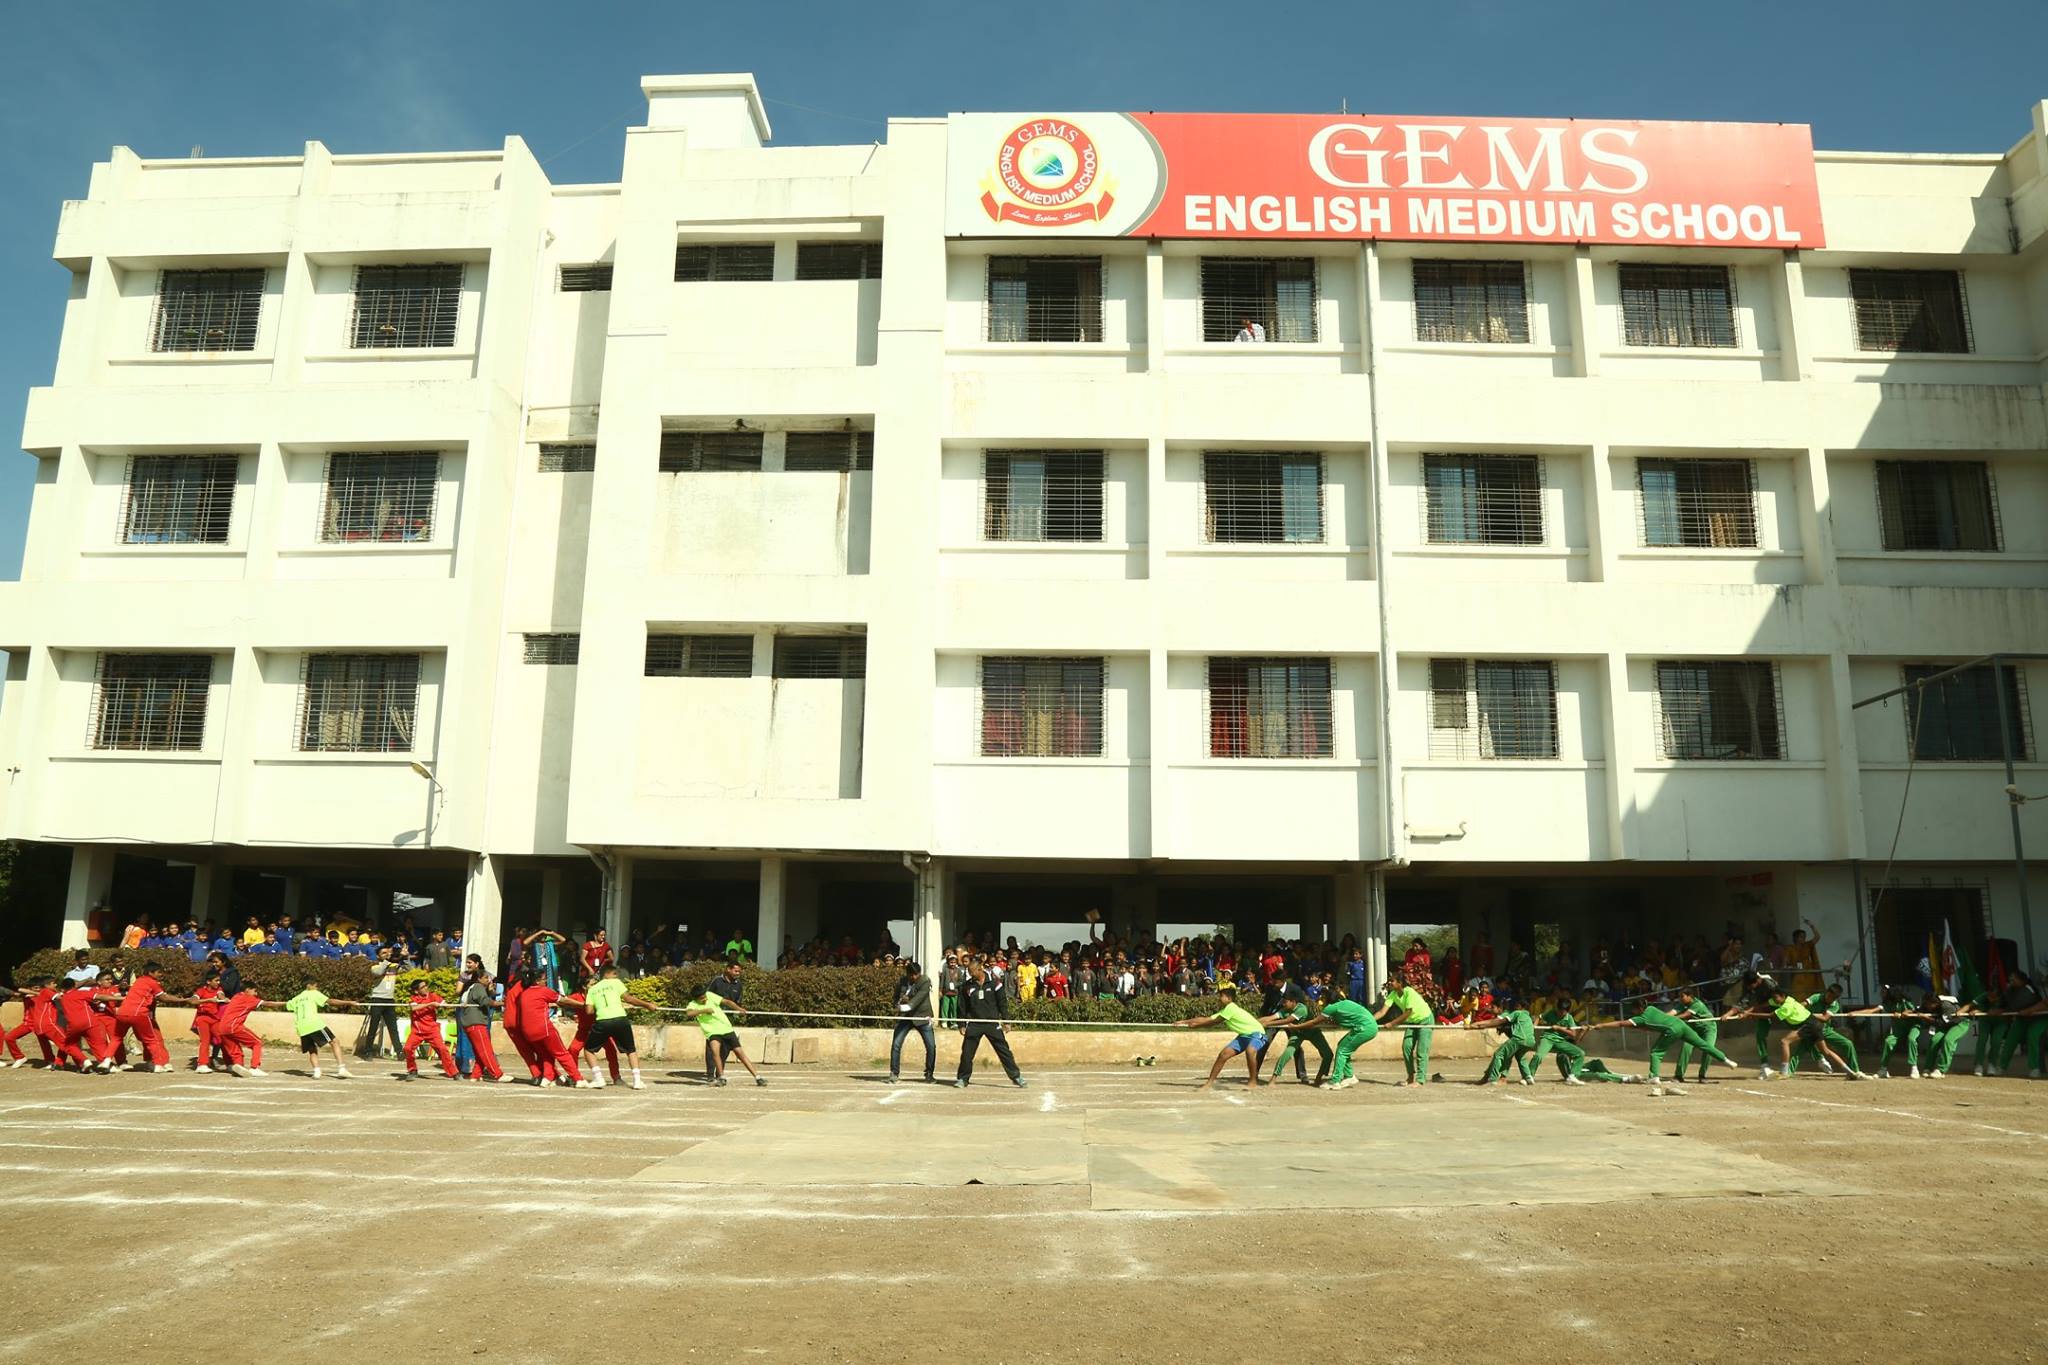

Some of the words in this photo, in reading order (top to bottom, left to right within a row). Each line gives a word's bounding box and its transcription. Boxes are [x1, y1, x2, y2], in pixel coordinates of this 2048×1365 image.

[1018, 123, 1078, 142] GEMS
[1308, 123, 1648, 194] GEMS
[1001, 145, 1025, 195] ENGLISH
[1025, 190, 1075, 205] MEDIUM
[1075, 143, 1096, 192] SCHOOL
[1185, 195, 1392, 233] ENGLISH
[1409, 198, 1597, 238] MEDIUM
[1612, 202, 1801, 241] SCHOOL
